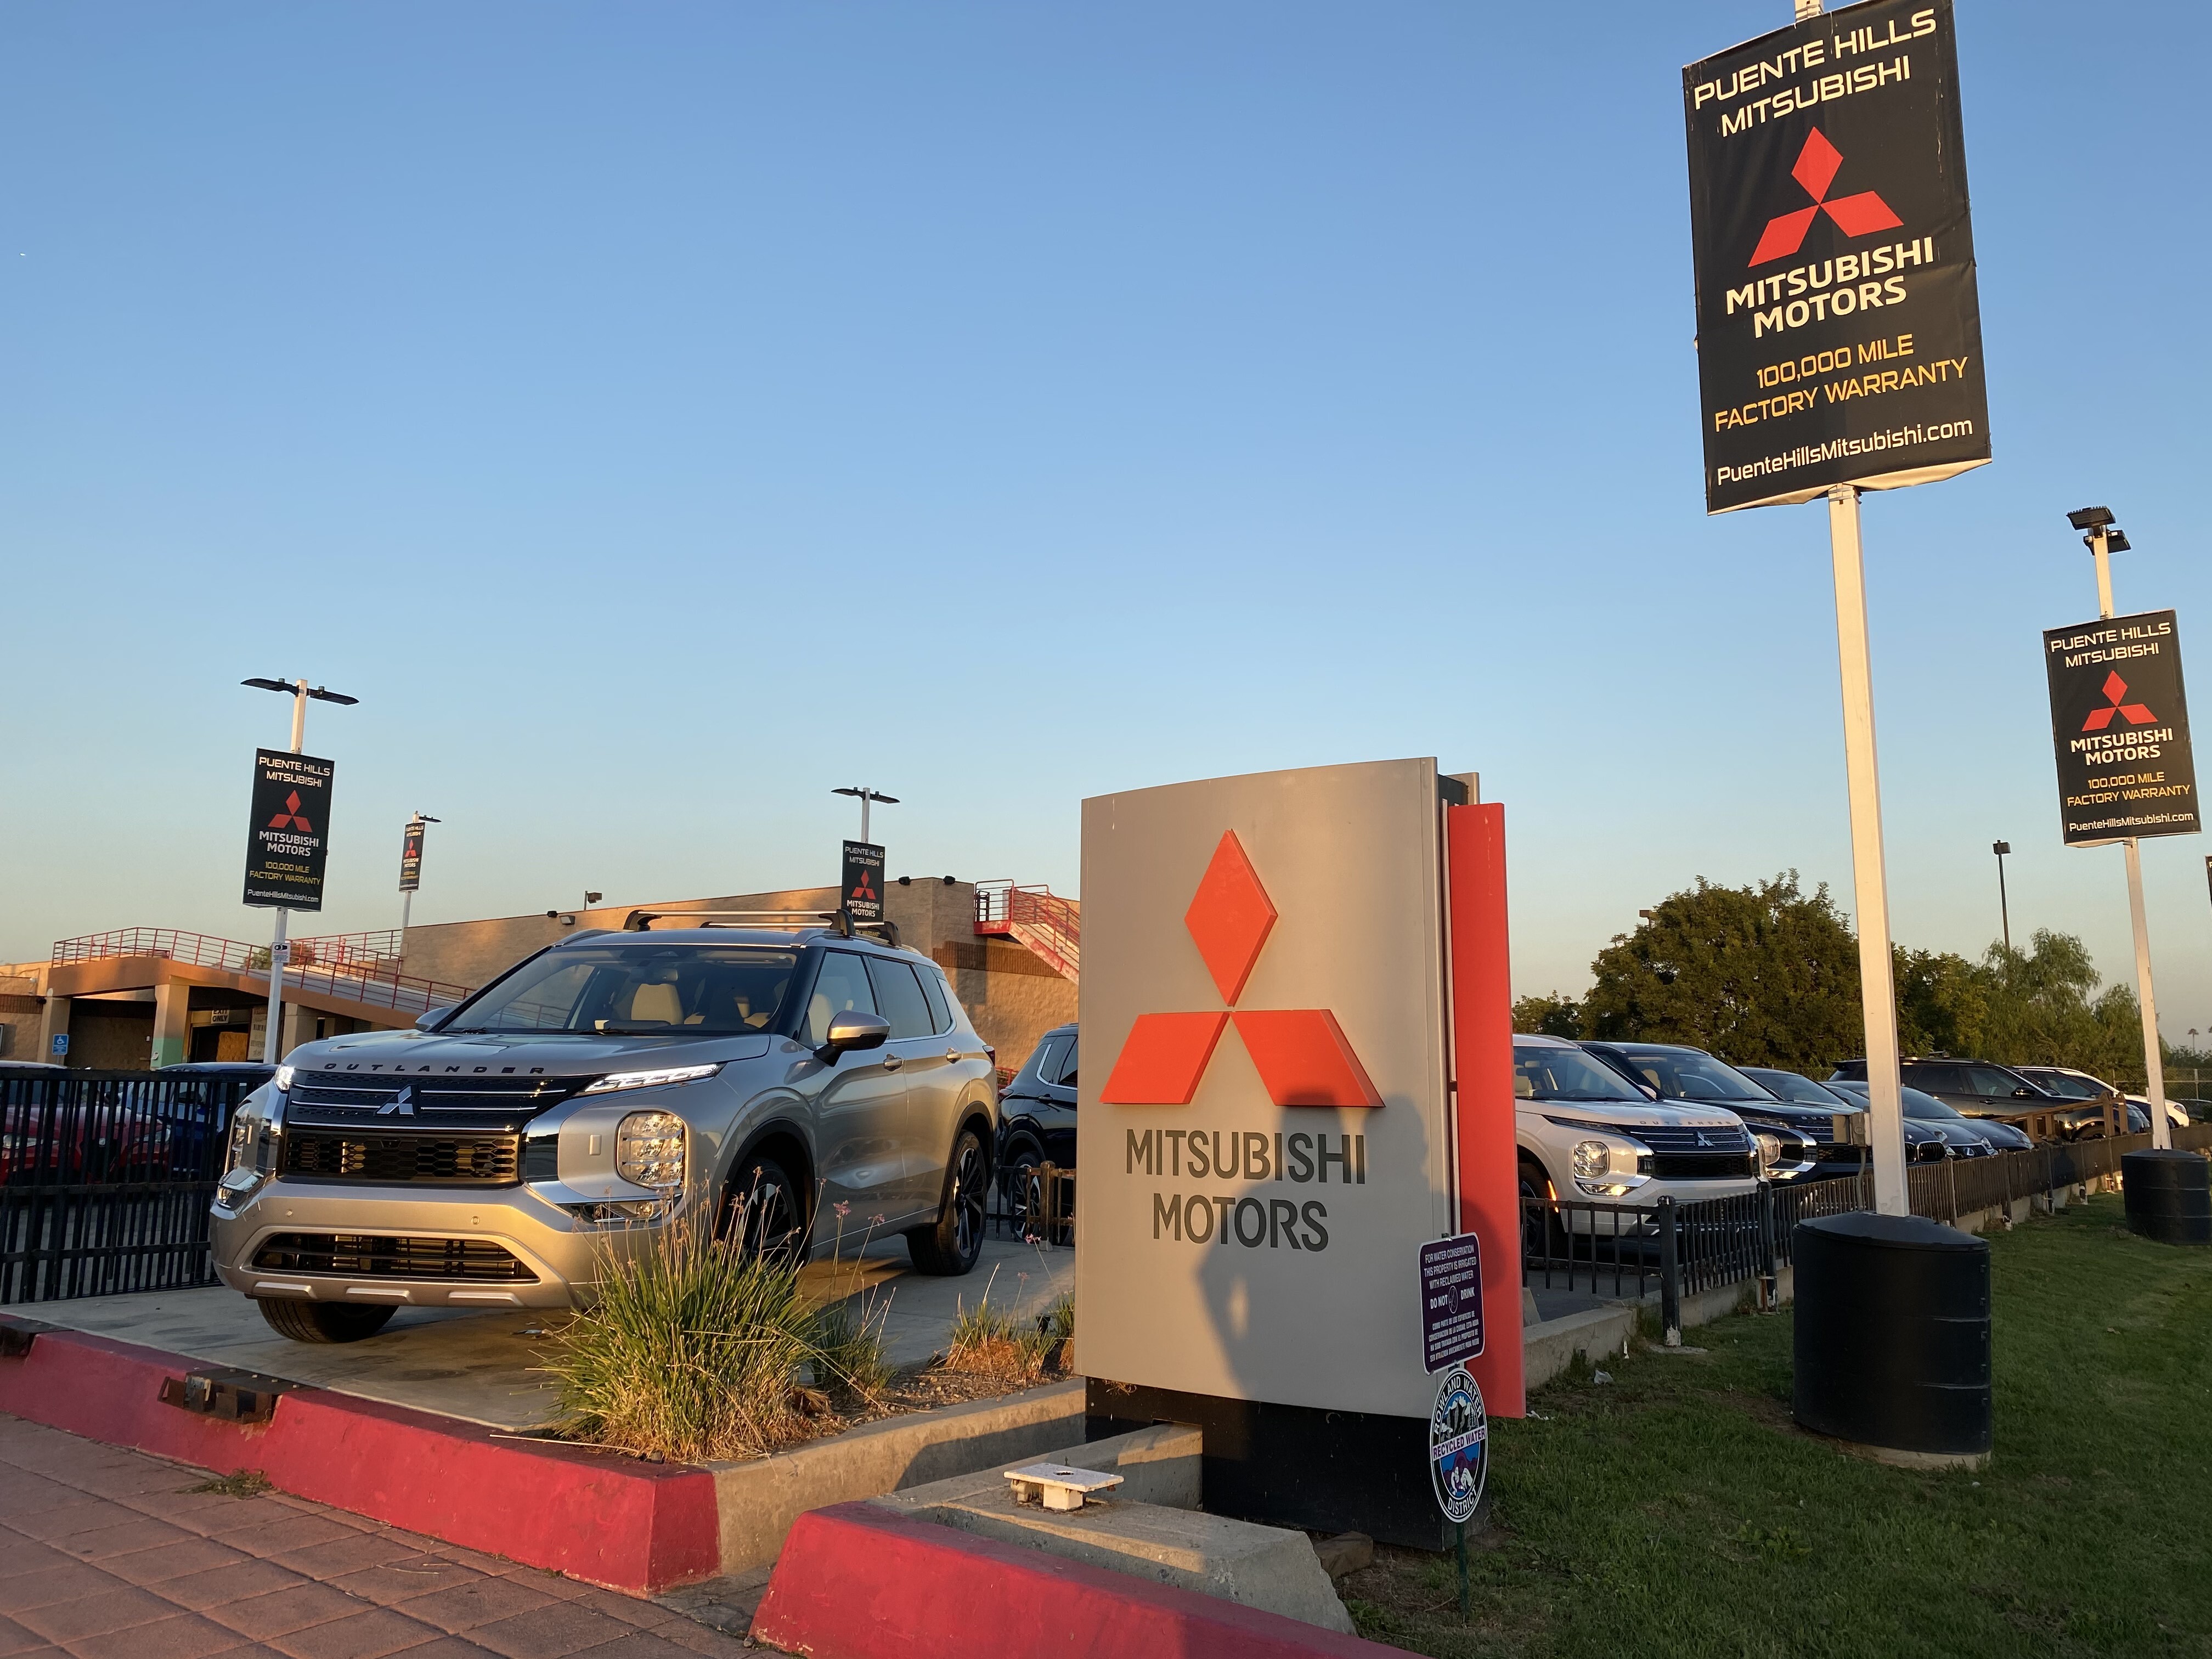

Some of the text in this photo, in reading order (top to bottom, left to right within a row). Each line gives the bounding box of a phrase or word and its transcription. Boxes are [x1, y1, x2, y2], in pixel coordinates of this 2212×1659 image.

[1694, 8, 1937, 110] PUENTE HILLS
[1721, 55, 1911, 137] MITSUBISHI
[1726, 236, 1934, 315] MITSUBISHI
[1754, 275, 1908, 338] MOTORS
[1756, 334, 1914, 389] 100,000 MILE
[1714, 357, 1968, 432] FACTORY WARRANTY
[1717, 419, 1973, 486] PuenteHillsMitsubishi.com
[2051, 622, 2171, 653] PUENTE HILLS
[2065, 642, 2159, 668] MITSUBISHI
[2070, 728, 2174, 753] MITSUBISHI
[2085, 744, 2161, 766] MOTORS
[259, 757, 330, 776] PUENTE HILLS
[266, 770, 322, 788] MITSUBISHI
[2087, 771, 2165, 789] 100,000 MILE
[2067, 784, 2191, 807] FACTORY WARRANTY
[2069, 812, 2194, 832] PuenteHillsMitsubishi.com
[259, 831, 319, 847] MITSUBISHI
[267, 842, 311, 856] MOTORS
[845, 846, 884, 859] PUENTE HILLS
[849, 856, 880, 867] MITSUBISHI
[249, 870, 321, 885] FACTORY WARRANTY
[265, 861, 310, 873] 100,000 MILE
[247, 889, 319, 902] PuenteHillsMitsubishi.com
[847, 900, 880, 911] MITSUBISHI
[851, 908, 876, 917] MOTORS
[324, 1063, 544, 1074] OUTLANDER
[1126, 1128, 1365, 1184] MITSUBISHI
[1153, 1193, 1329, 1252] MOTORS
[1425, 1244, 1474, 1263] FOR WATER CONSERVATION
[1424, 1256, 1476, 1277] THIS PROPERTY IS IRRIGATED
[1429, 1270, 1474, 1290] WITH RECLAIMED WATER
[1430, 1286, 1475, 1309] DO NOT DRINK
[1434, 1376, 1482, 1435] ROWLAND WATER
[1433, 1427, 1485, 1459] RECYCLED WATER
[1448, 1484, 1477, 1515] DISTRICT
